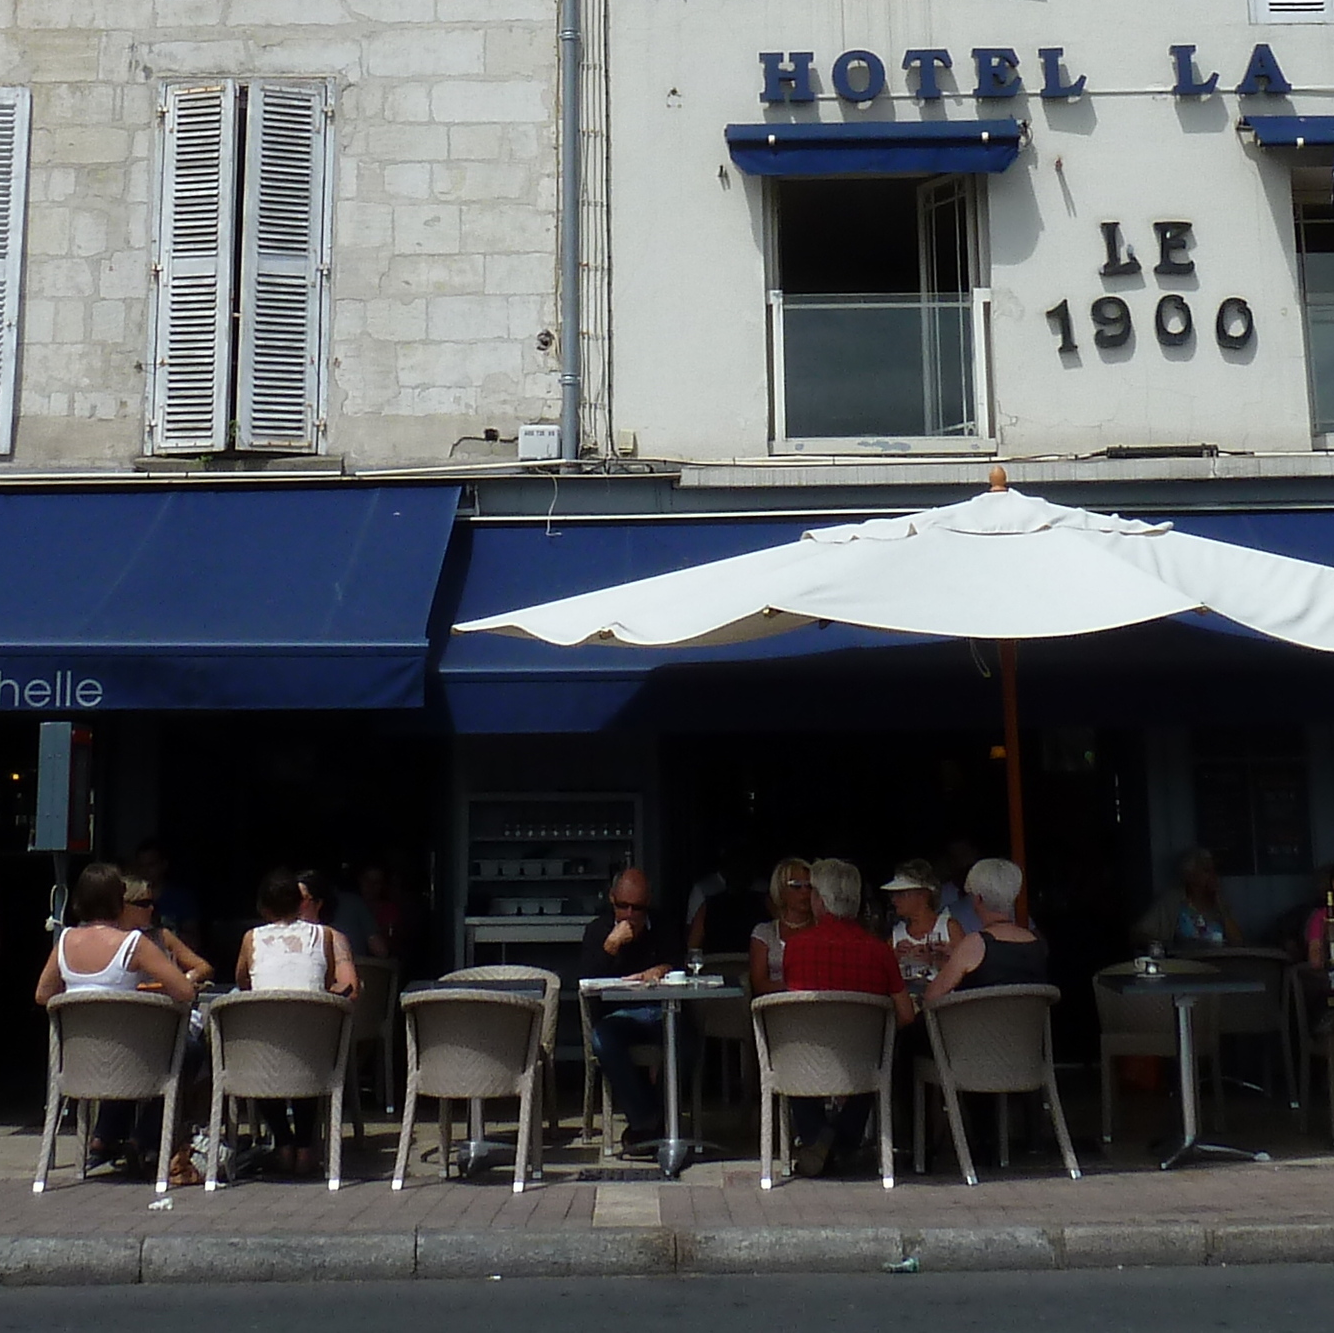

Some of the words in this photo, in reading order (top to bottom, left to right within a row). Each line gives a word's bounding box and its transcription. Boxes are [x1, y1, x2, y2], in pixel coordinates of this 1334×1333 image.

[759, 46, 1088, 103] HOTEL
[1169, 43, 1293, 96] LA
[1098, 221, 1195, 276] LE
[1045, 294, 1254, 350] 1900
